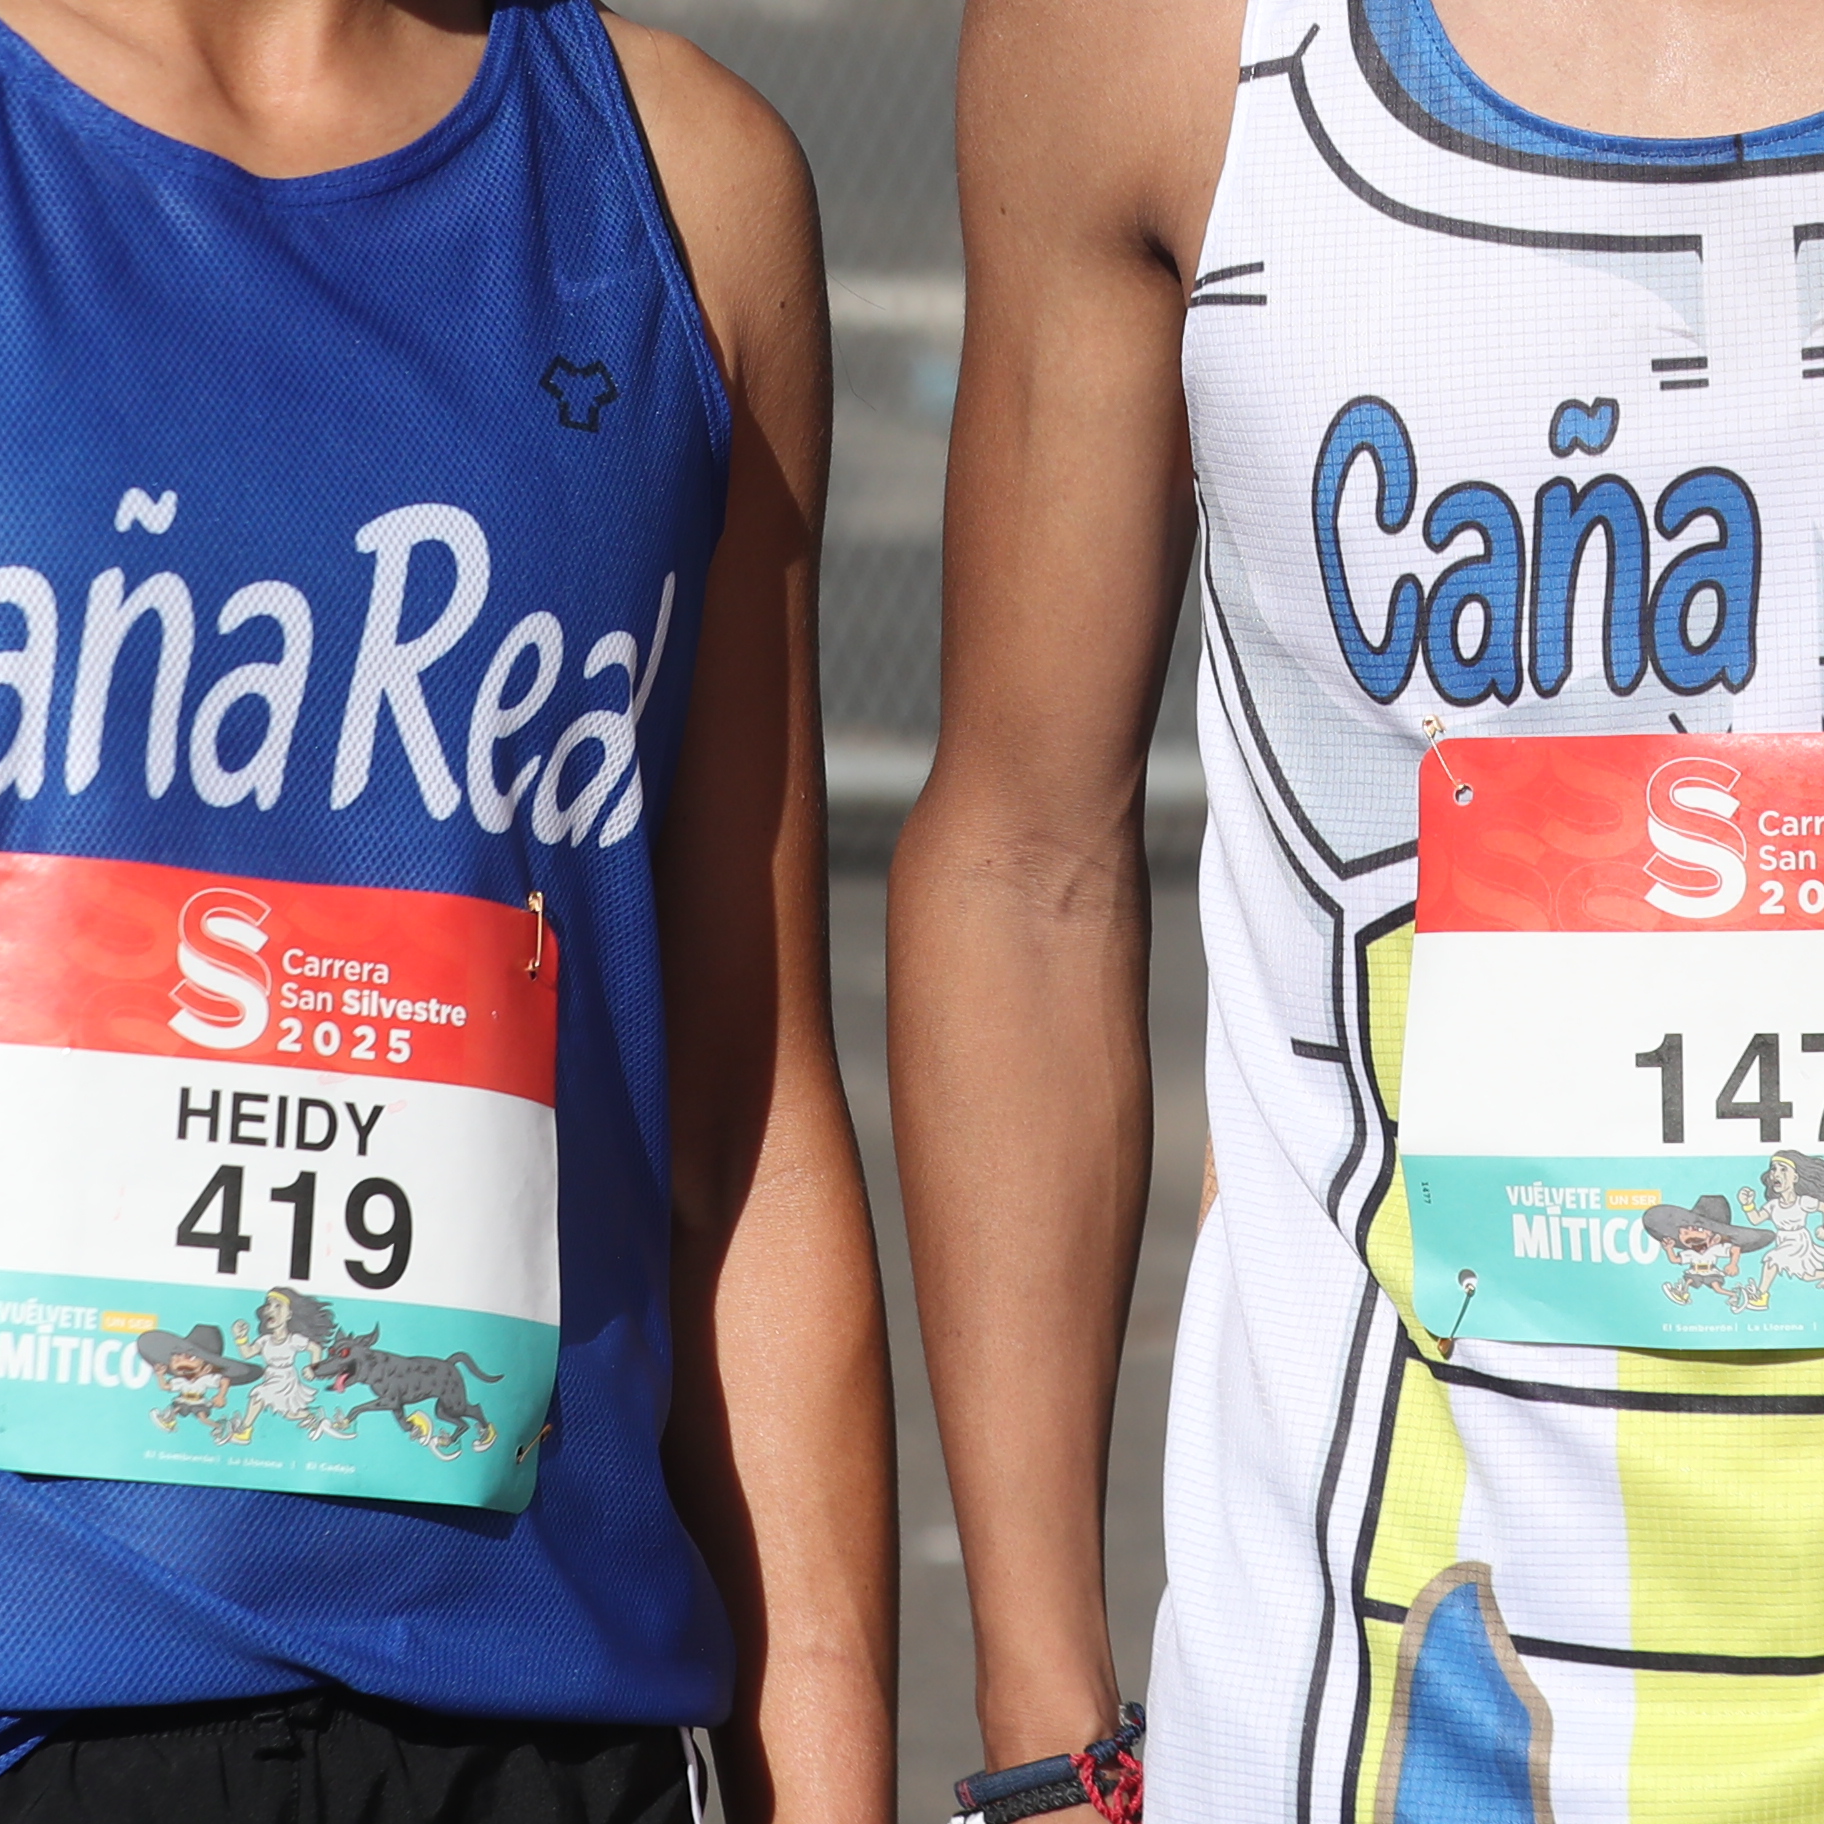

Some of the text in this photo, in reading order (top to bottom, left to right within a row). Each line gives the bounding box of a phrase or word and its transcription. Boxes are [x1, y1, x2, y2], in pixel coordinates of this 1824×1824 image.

[1312, 394, 1761, 705] Caña
[330, 502, 676, 848] Real
[1758, 845, 1817, 871] San
[281, 948, 390, 984] Carrera
[279, 982, 467, 1027] San Silvestre
[277, 1017, 412, 1064] 2025
[177, 1087, 385, 1157] HEIDY
[1505, 1181, 1657, 1210] VUÉLVETE UN SER
[176, 1164, 413, 1291] 419
[1512, 1205, 1661, 1265] MÍTICO
